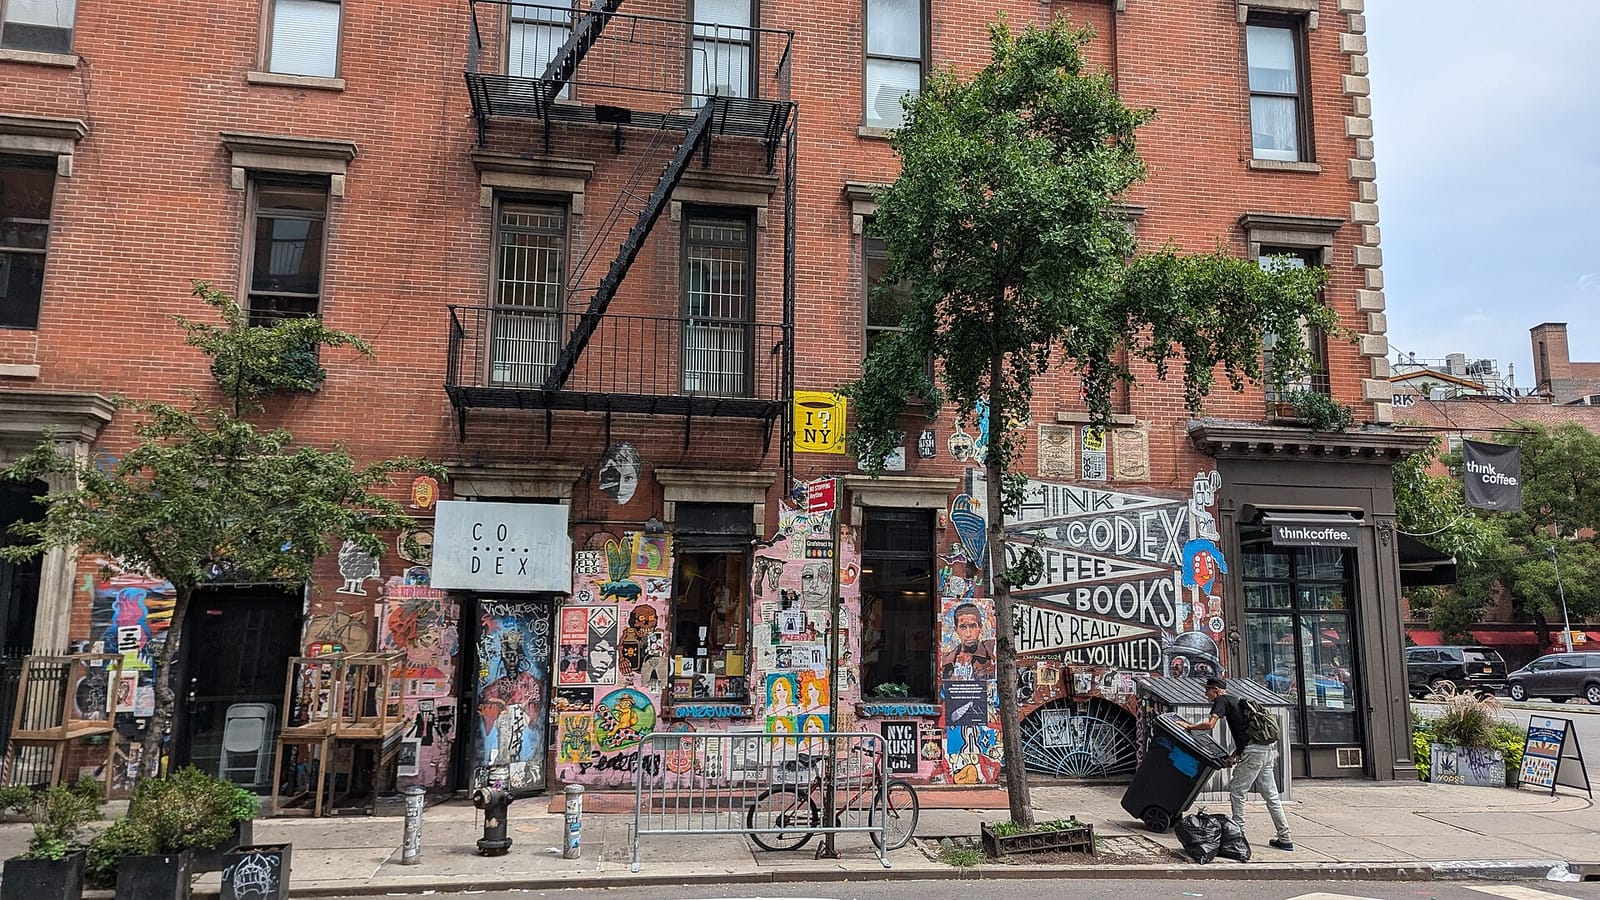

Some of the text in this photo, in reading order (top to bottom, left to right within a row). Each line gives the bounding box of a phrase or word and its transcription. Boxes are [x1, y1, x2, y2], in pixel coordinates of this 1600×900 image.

[805, 411, 813, 425] I
[803, 428, 831, 444] NY
[1466, 461, 1497, 475] think
[1482, 473, 1518, 486] coffee.
[1018, 484, 1115, 521] HINK
[1067, 506, 1188, 566] CODEX
[1280, 526, 1351, 540] thinkcoffee.
[471, 556, 528, 576] DEX
[1005, 544, 1106, 586] OFFEE
[1076, 578, 1174, 627] BOOKS
[1020, 606, 1121, 651] HAT'S REALLY
[1064, 637, 1162, 671] ALL YOU NEED
[887, 725, 913, 740] NYC
